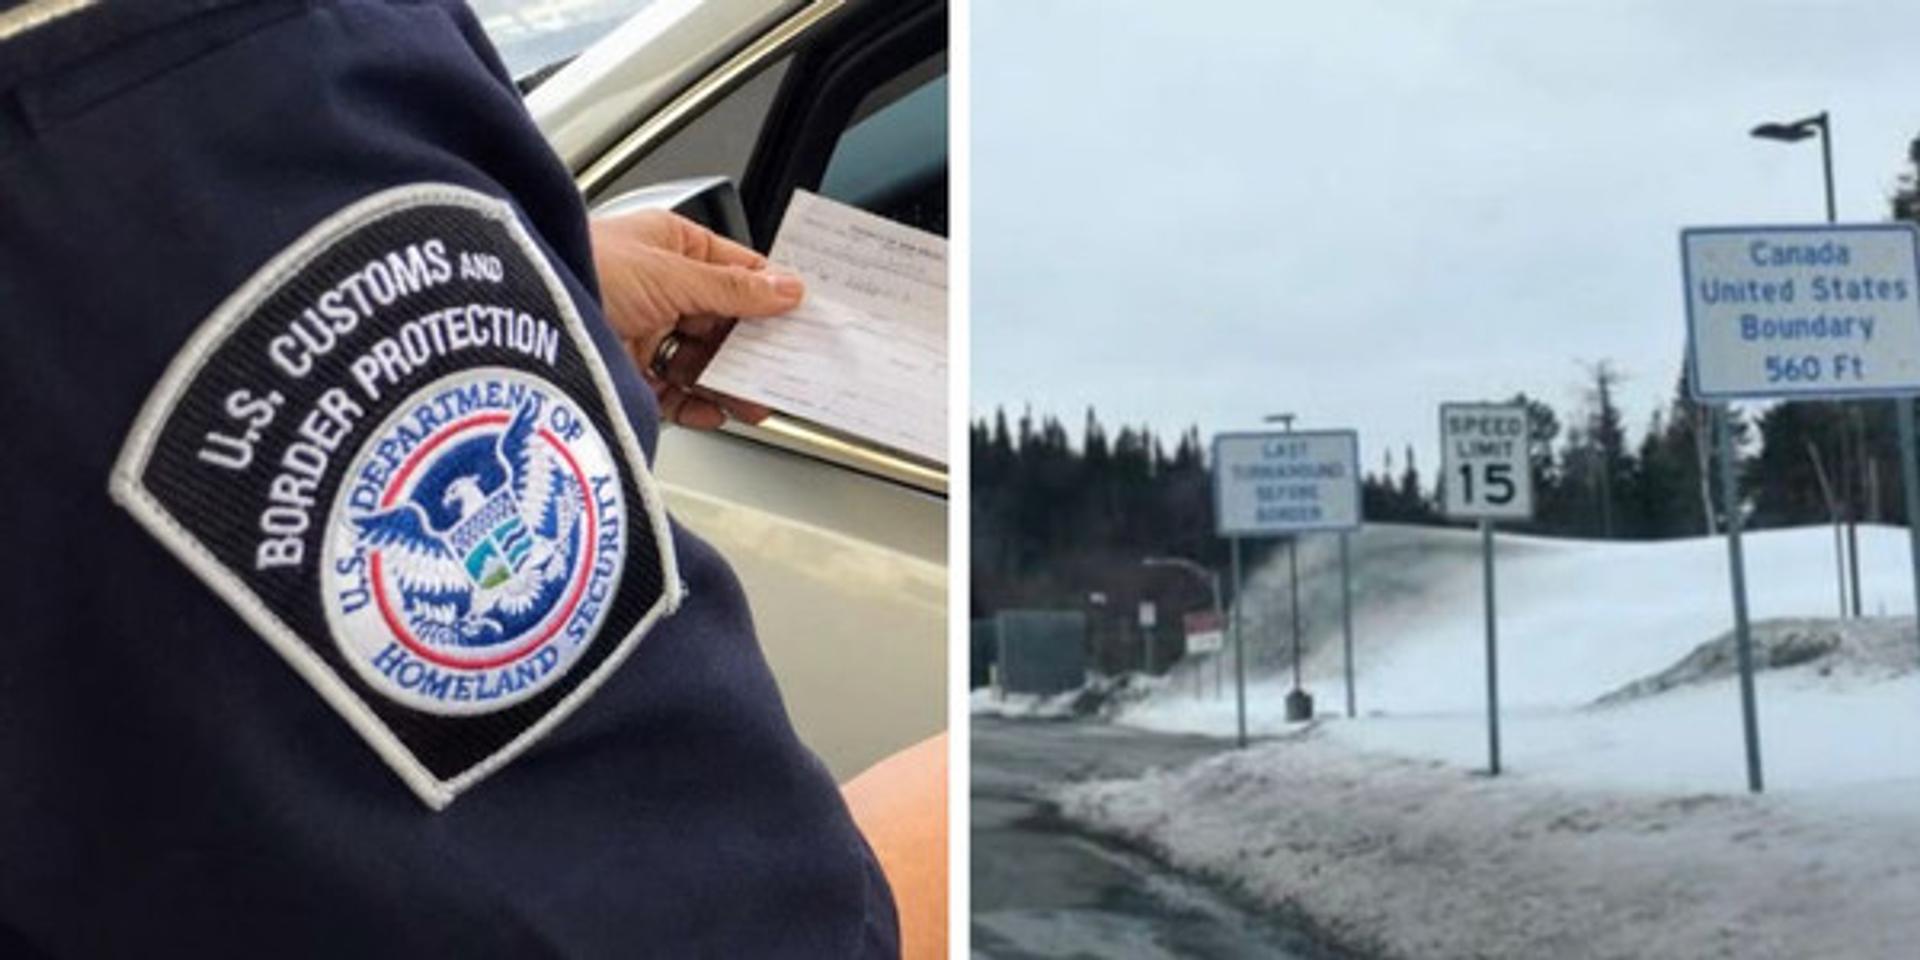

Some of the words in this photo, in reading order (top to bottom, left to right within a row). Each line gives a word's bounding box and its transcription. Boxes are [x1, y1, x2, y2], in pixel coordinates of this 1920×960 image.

[1749, 240, 1850, 267] Canada
[1700, 277, 1795, 305] United
[1811, 275, 1909, 301] States
[1740, 312, 1875, 342] Boundary
[199, 390, 286, 470] U.S.
[269, 239, 453, 377] CUSTOMS
[460, 251, 503, 283] AND
[1763, 354, 1821, 382] 560
[1833, 353, 1864, 381] Ft
[256, 387, 364, 570] BORDER
[351, 304, 560, 399] PROTECTION
[1449, 416, 1522, 437] SPEED
[348, 381, 547, 512] DEPARTMENT
[550, 405, 584, 442] OF
[1457, 440, 1514, 459] LIMIT
[1458, 462, 1517, 505] 15
[371, 642, 560, 702] HOMELAND
[566, 472, 621, 645] SECURITY
